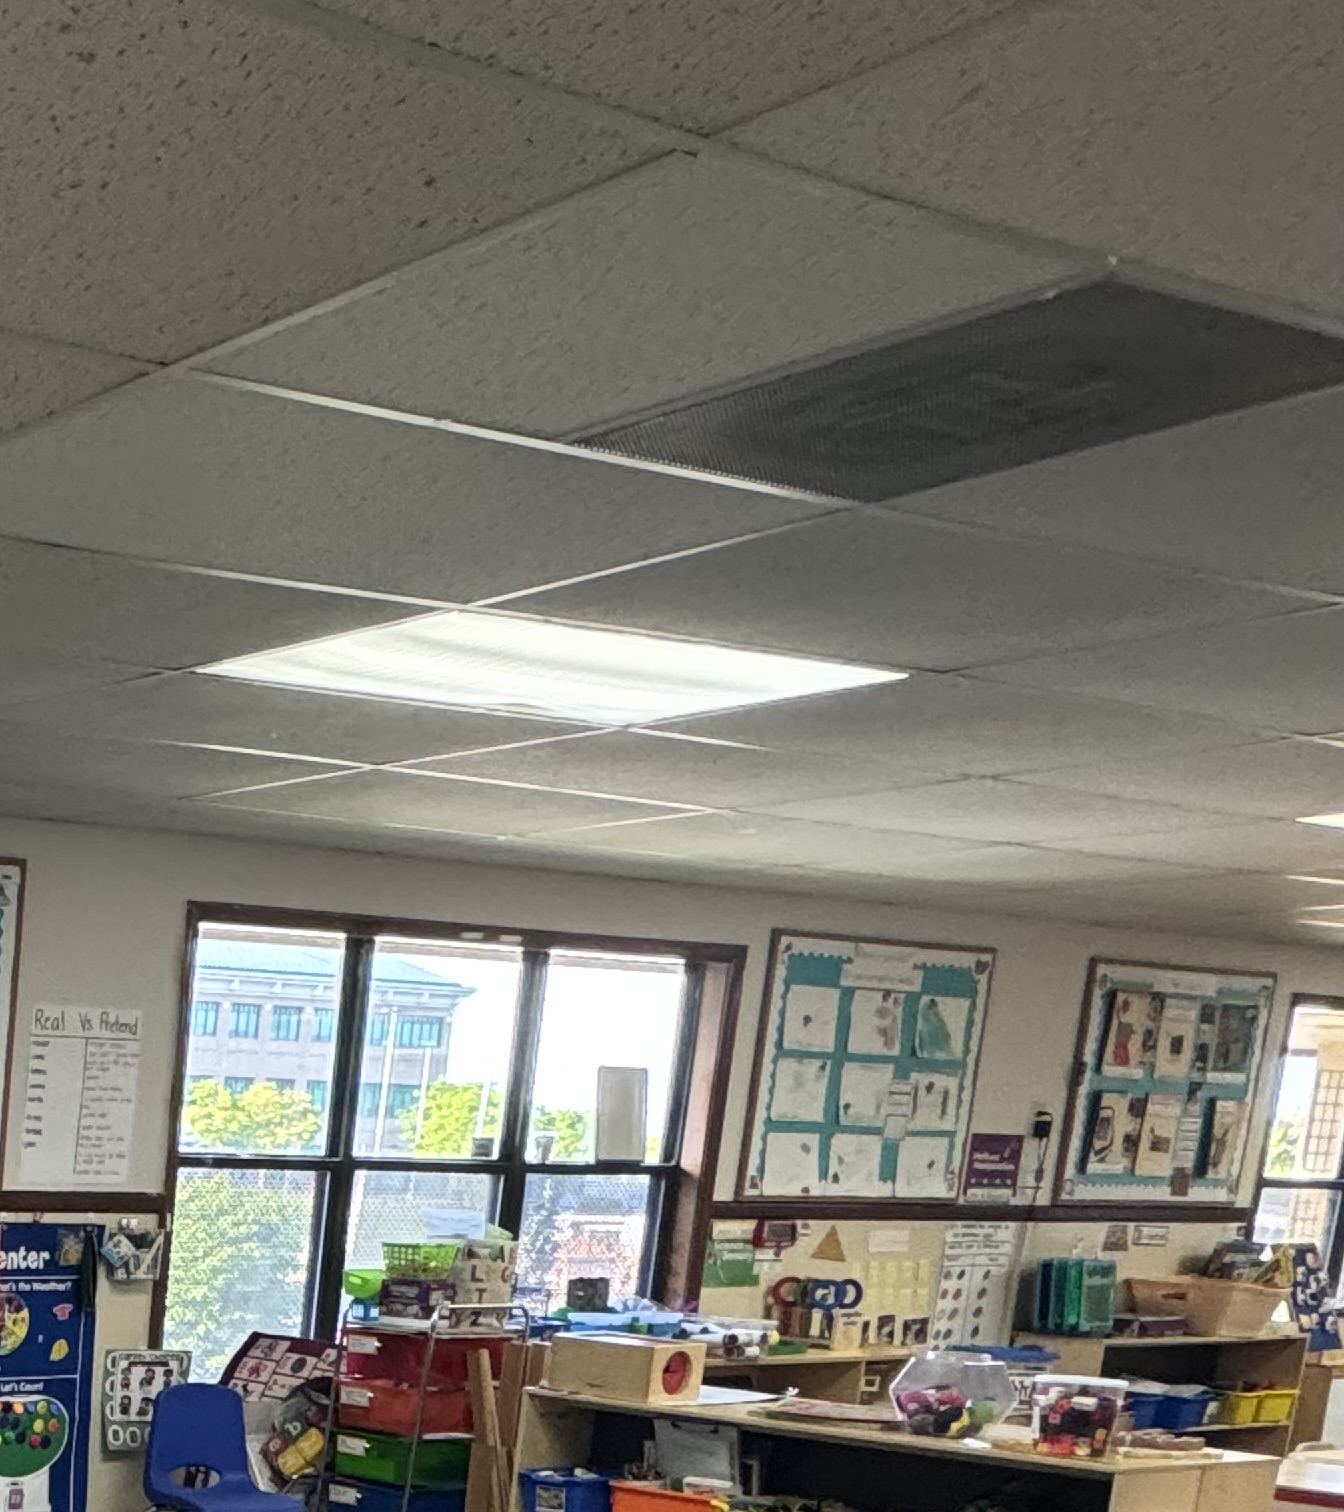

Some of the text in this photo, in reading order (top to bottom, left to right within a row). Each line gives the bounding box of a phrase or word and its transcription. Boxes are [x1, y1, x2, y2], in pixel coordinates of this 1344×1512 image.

[33, 1008, 66, 1032] Real
[98, 1010, 139, 1037] Pretend
[0, 1245, 51, 1271] enter
